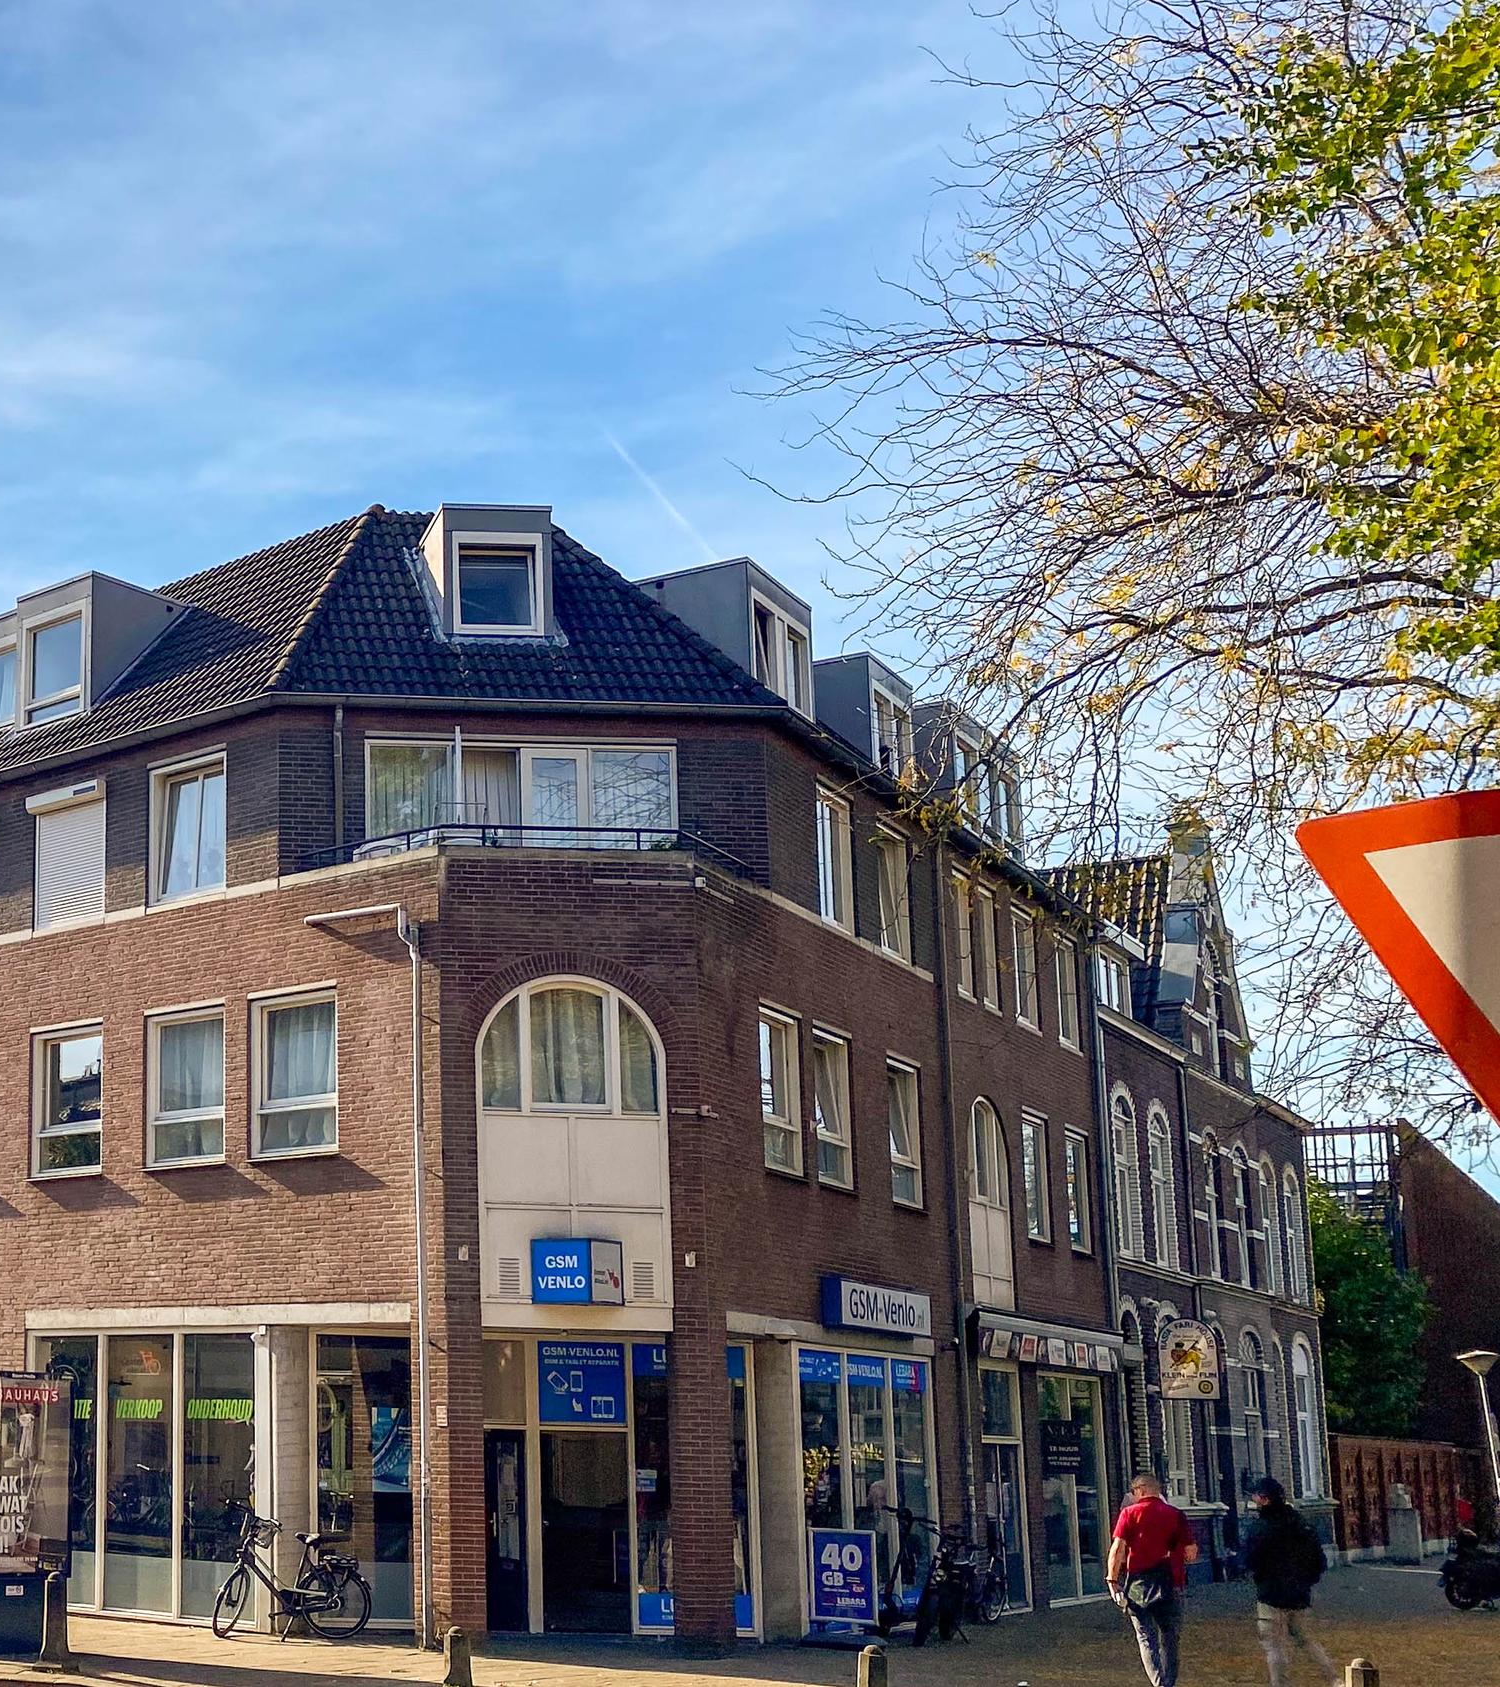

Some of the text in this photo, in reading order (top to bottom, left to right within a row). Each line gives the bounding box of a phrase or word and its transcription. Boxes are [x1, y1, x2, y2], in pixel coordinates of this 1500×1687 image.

[545, 1256, 578, 1268] GSM
[538, 1276, 586, 1289] VENLO
[116, 1399, 163, 1419] VERKOOP
[187, 1399, 253, 1420] ONDERHOUD
[821, 1543, 863, 1571] 40
[821, 1571, 844, 1586] GB
[836, 1597, 866, 1607] LEBARA
